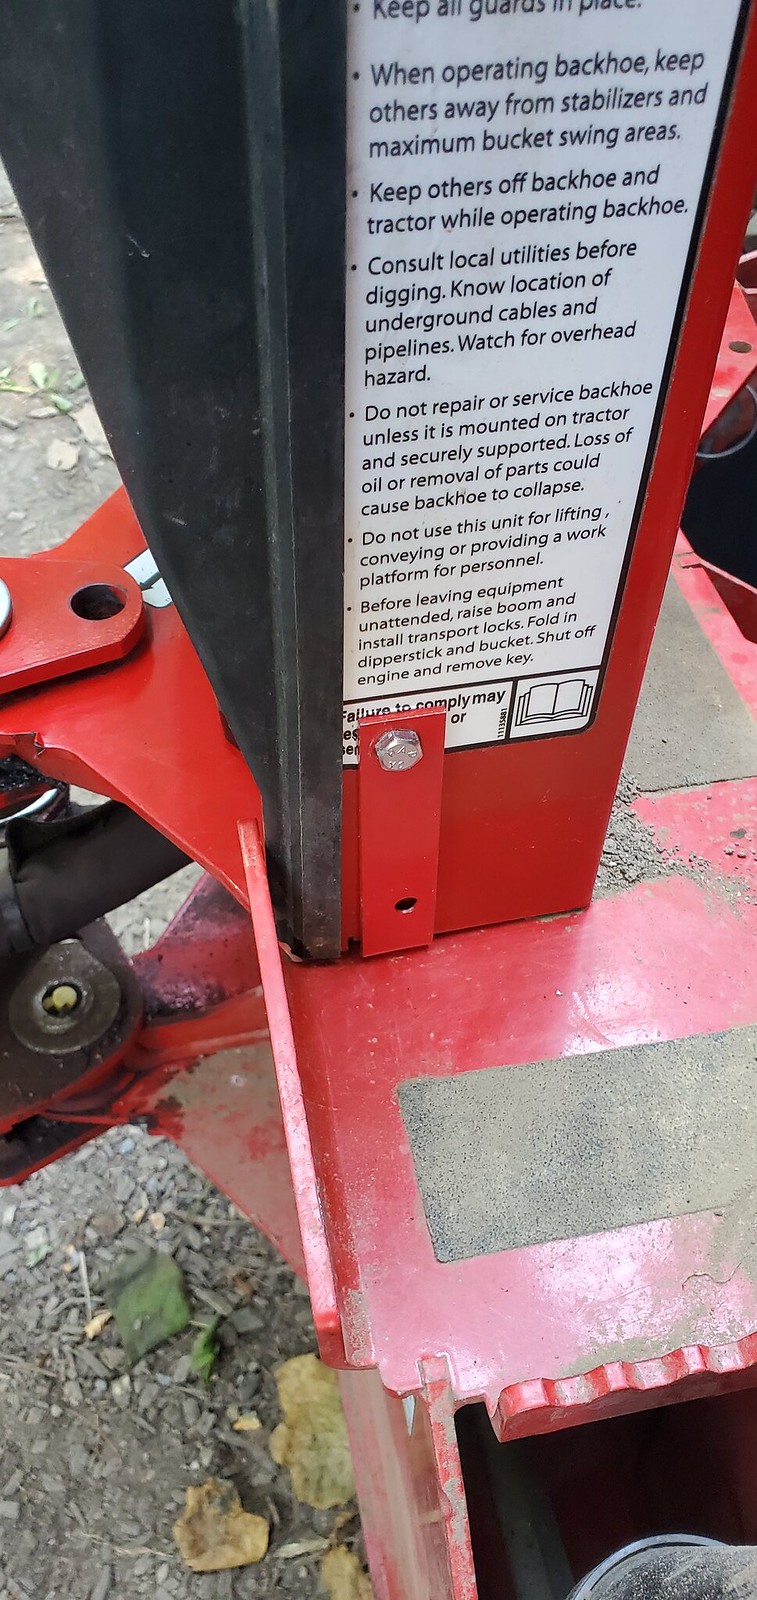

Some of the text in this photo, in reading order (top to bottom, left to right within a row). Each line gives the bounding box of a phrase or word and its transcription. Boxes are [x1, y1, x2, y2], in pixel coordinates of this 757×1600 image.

[374, 0, 430, 24] Keep
[437, 0, 461, 16] all
[469, 0, 545, 22] guards
[371, 49, 704, 88] When operating backhoe, keep
[369, 82, 709, 123] others away from stabilizers and
[369, 124, 680, 158] maximum bucket swing areas.
[370, 164, 661, 205] Keep others off backhoe and
[367, 195, 688, 235] tractor while operating backhoe.
[368, 239, 637, 275] Consult local utilities before
[366, 267, 613, 308] digging. Know location of
[366, 296, 598, 333] underground cables and
[365, 320, 637, 365] pipelines. Watch for overhead
[364, 364, 431, 387] hazard.
[365, 380, 653, 422] Do not repair or service backhoe
[363, 408, 630, 446] unless it is mounted on tractor
[362, 426, 634, 470] and securely supported. Loss of
[362, 452, 601, 494] oil or removal of parts could
[361, 481, 584, 516] cause backhoe to collapse.
[360, 524, 607, 567] conveying or providing a work
[362, 532, 386, 546] Do
[391, 528, 419, 542] not
[424, 525, 452, 538] use
[457, 518, 486, 534] this
[491, 514, 524, 530] unit
[528, 511, 551, 526] for
[360, 551, 543, 591] platform for personnel.
[359, 592, 576, 632] unattended, raise boom and
[361, 577, 564, 614] Before leaving equipment
[358, 624, 597, 669] dipperstick and bucket. Shut off
[359, 611, 577, 651] install transport locks. Fold in
[357, 653, 533, 686] engine and remove key.
[416, 694, 470, 711] comply
[472, 690, 506, 705] may
[450, 712, 467, 724] or
[497, 707, 508, 738] 11135881
